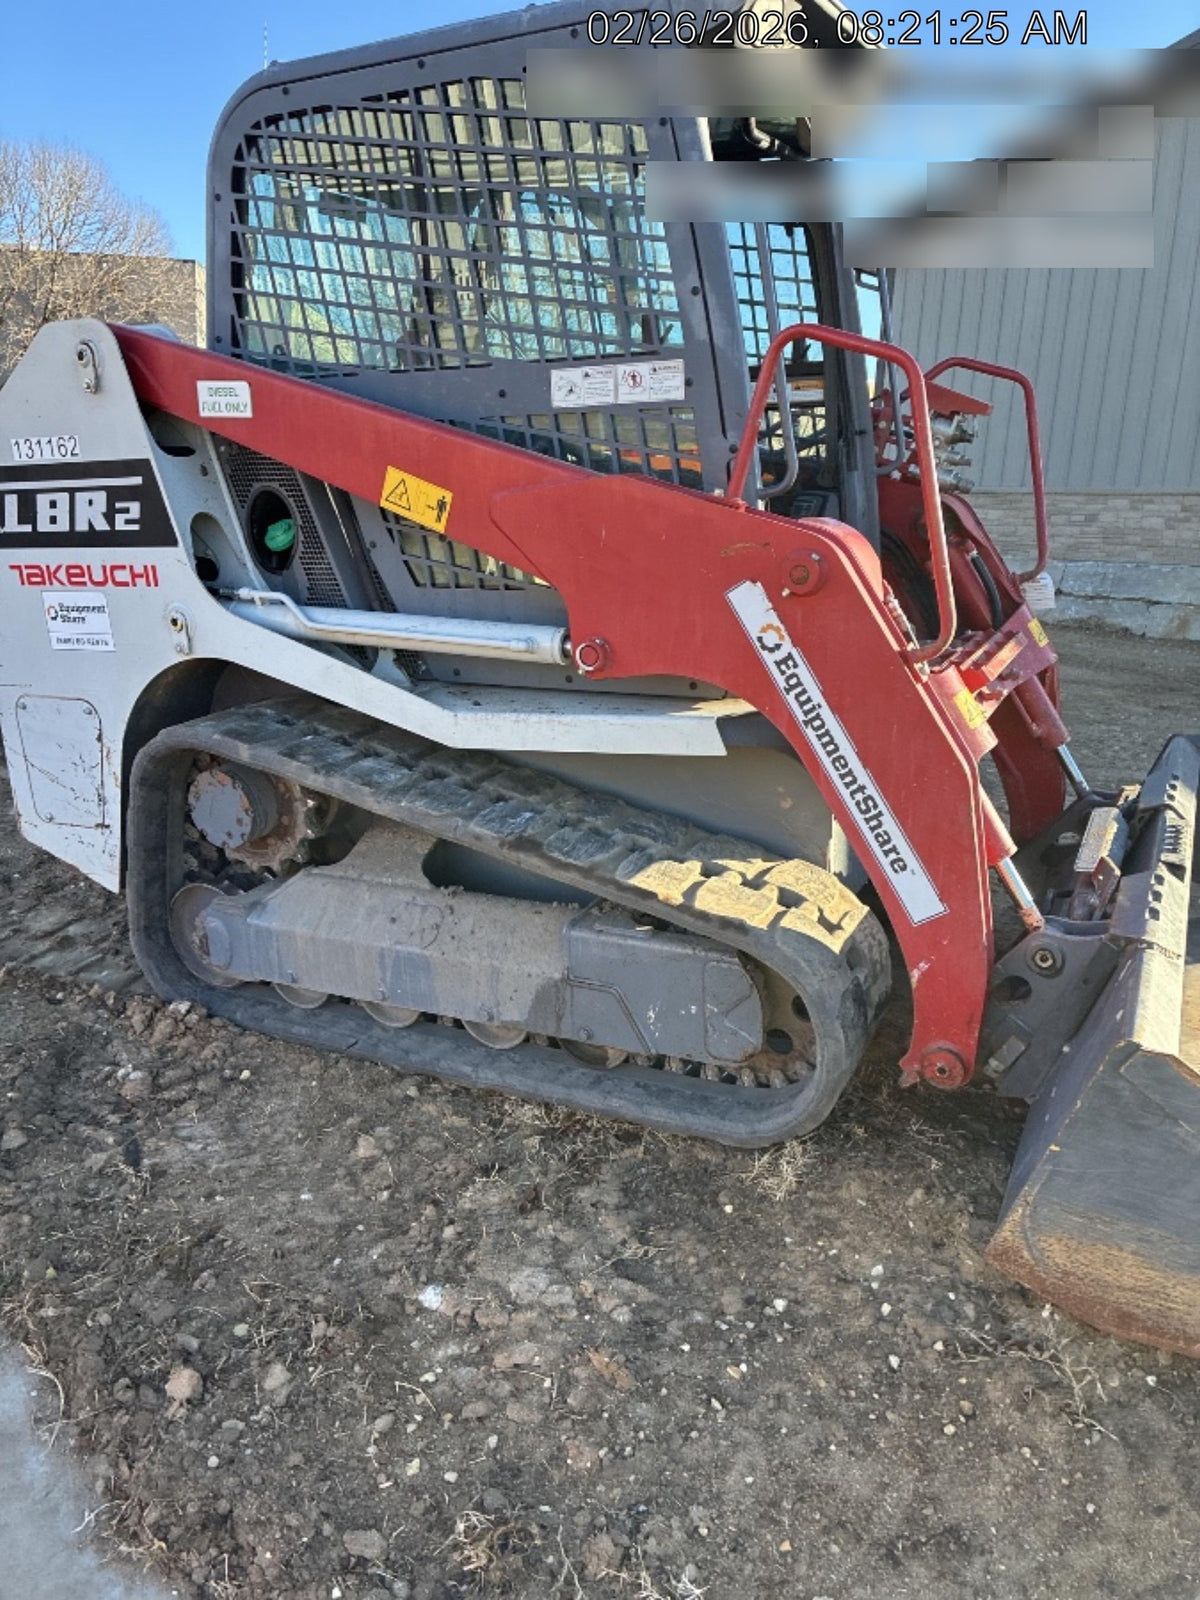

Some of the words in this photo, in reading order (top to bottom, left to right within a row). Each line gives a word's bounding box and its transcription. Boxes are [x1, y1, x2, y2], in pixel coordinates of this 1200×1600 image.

[207, 387, 239, 397] DIESEL
[202, 402, 224, 413] FUEL
[225, 401, 247, 413] ONLY
[13, 436, 79, 459] 131162
[0, 490, 141, 534] L8R2
[773, 652, 908, 874] EquipmentShare
